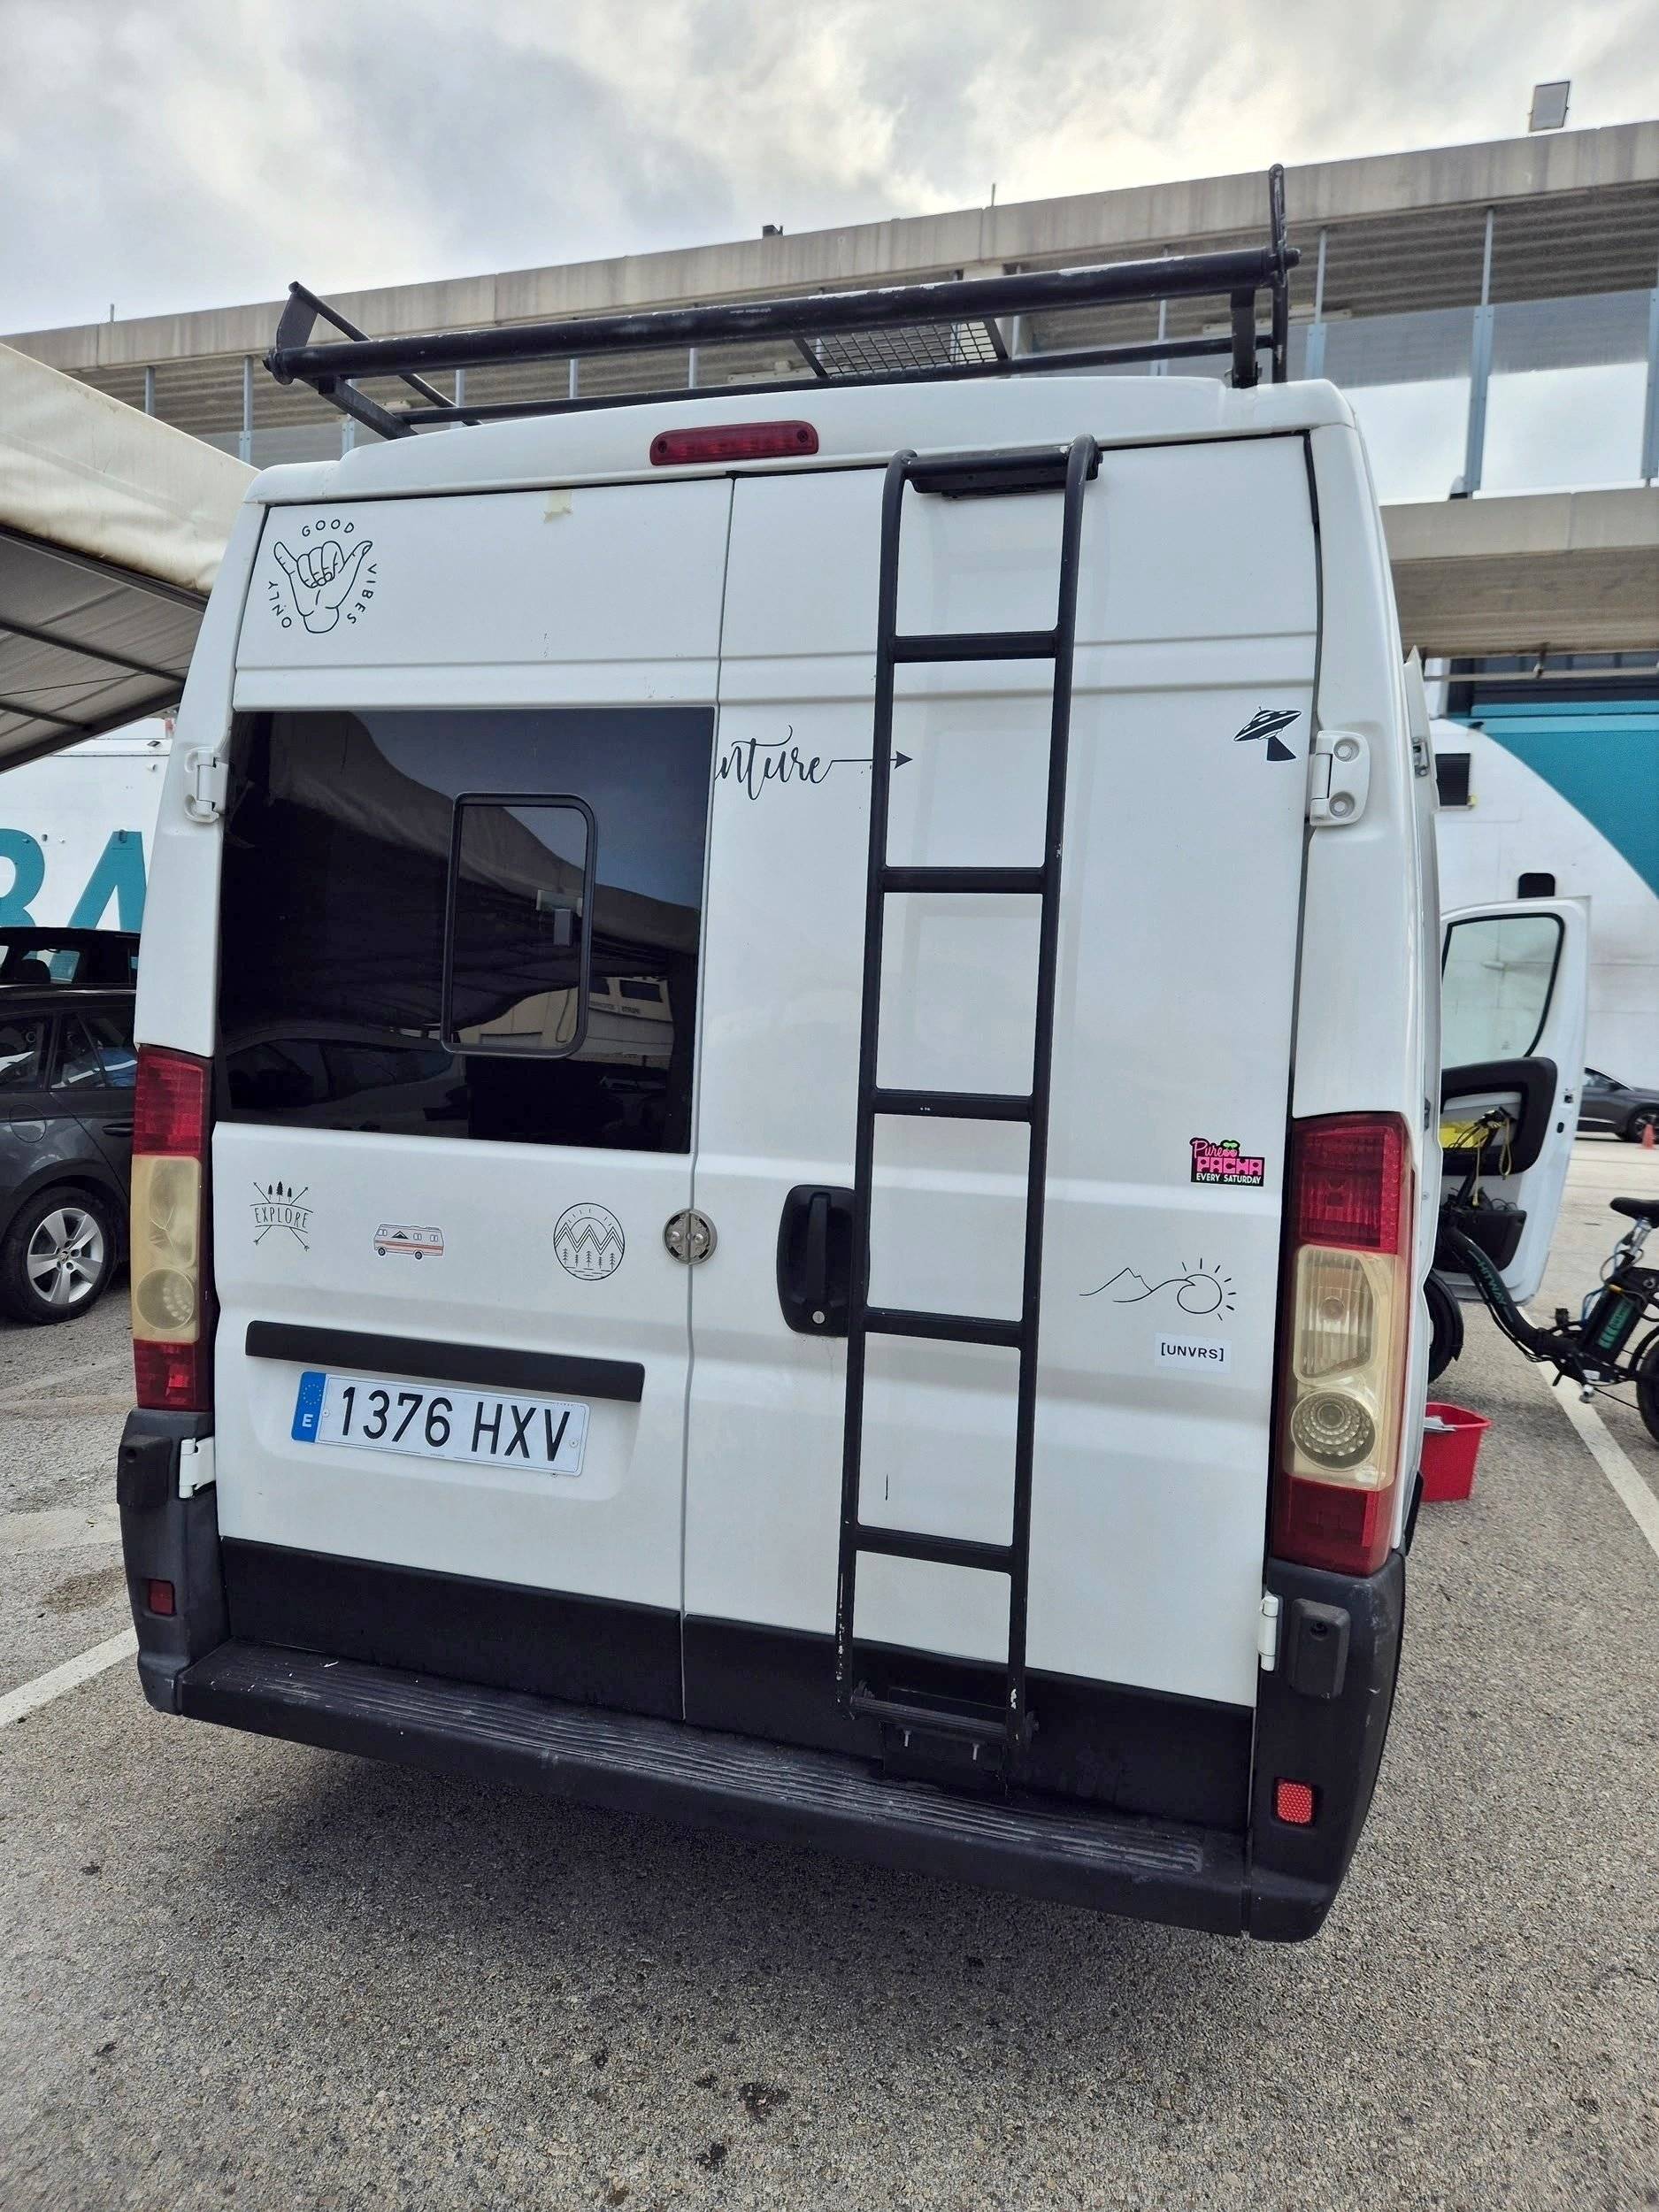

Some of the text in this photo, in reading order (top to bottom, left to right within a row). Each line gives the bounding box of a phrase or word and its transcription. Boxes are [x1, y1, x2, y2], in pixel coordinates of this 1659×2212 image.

[302, 518, 355, 537] GOOD
[268, 580, 292, 628] ONLY
[346, 563, 378, 624] VIBES
[1192, 1140, 1225, 1159] Pure
[1196, 1156, 1263, 1176] PACHA
[1195, 1172, 1262, 1185] EVERY SATURDAY
[254, 1206, 309, 1228] EXPLORE
[1476, 1259, 1509, 1306] HITWAY
[1161, 1341, 1224, 1363] [UNVRS]
[302, 1413, 312, 1428] E
[342, 1386, 571, 1462] 1376 HXV
